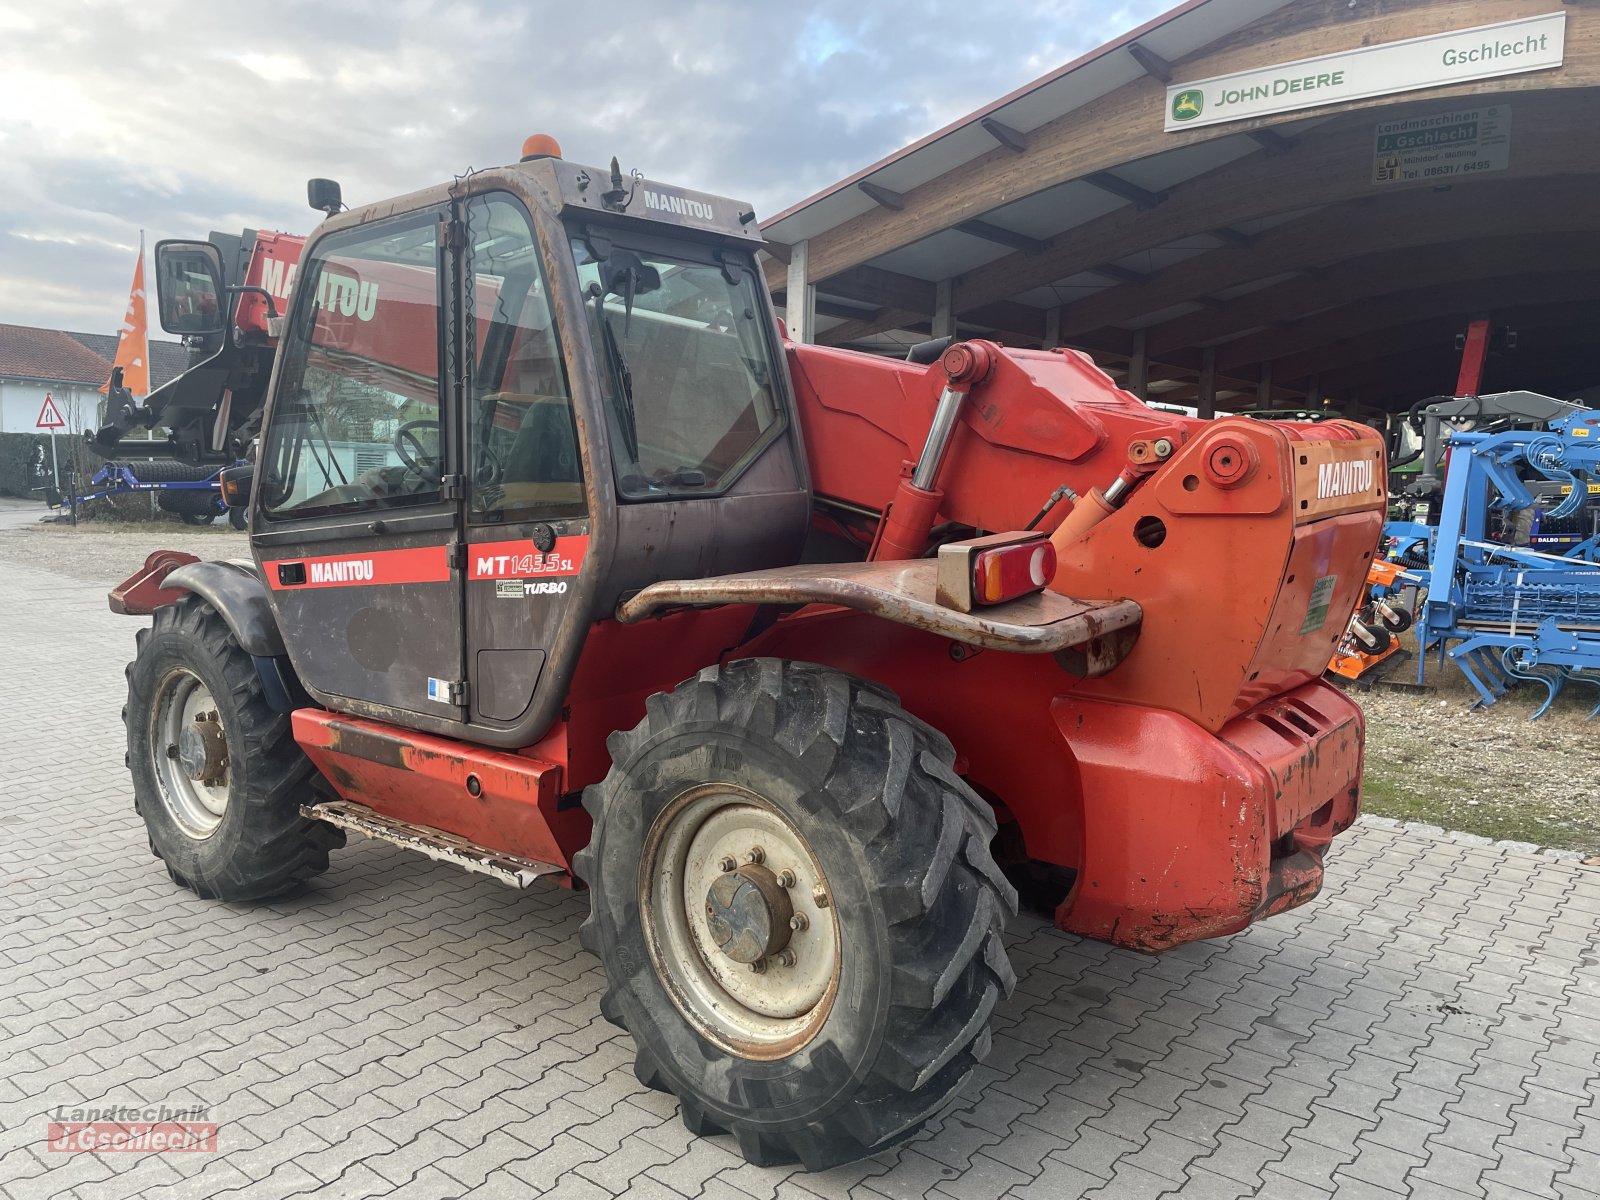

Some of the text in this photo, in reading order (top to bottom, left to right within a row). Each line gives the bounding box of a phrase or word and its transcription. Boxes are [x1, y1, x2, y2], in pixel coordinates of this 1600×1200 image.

[1442, 33, 1548, 67] Gschlecht
[1214, 71, 1345, 107] JOHN DEERE
[1378, 111, 1479, 134] Landmaschinen
[1381, 138, 1393, 150] J.
[1397, 126, 1474, 147] Gschlecht
[1463, 160, 1490, 171] 6495
[643, 190, 714, 221] MANITOU
[261, 257, 379, 322] MAITOU
[1317, 459, 1373, 499] MANITOU
[311, 559, 374, 583] MANITOU
[524, 582, 567, 595] TURBO
